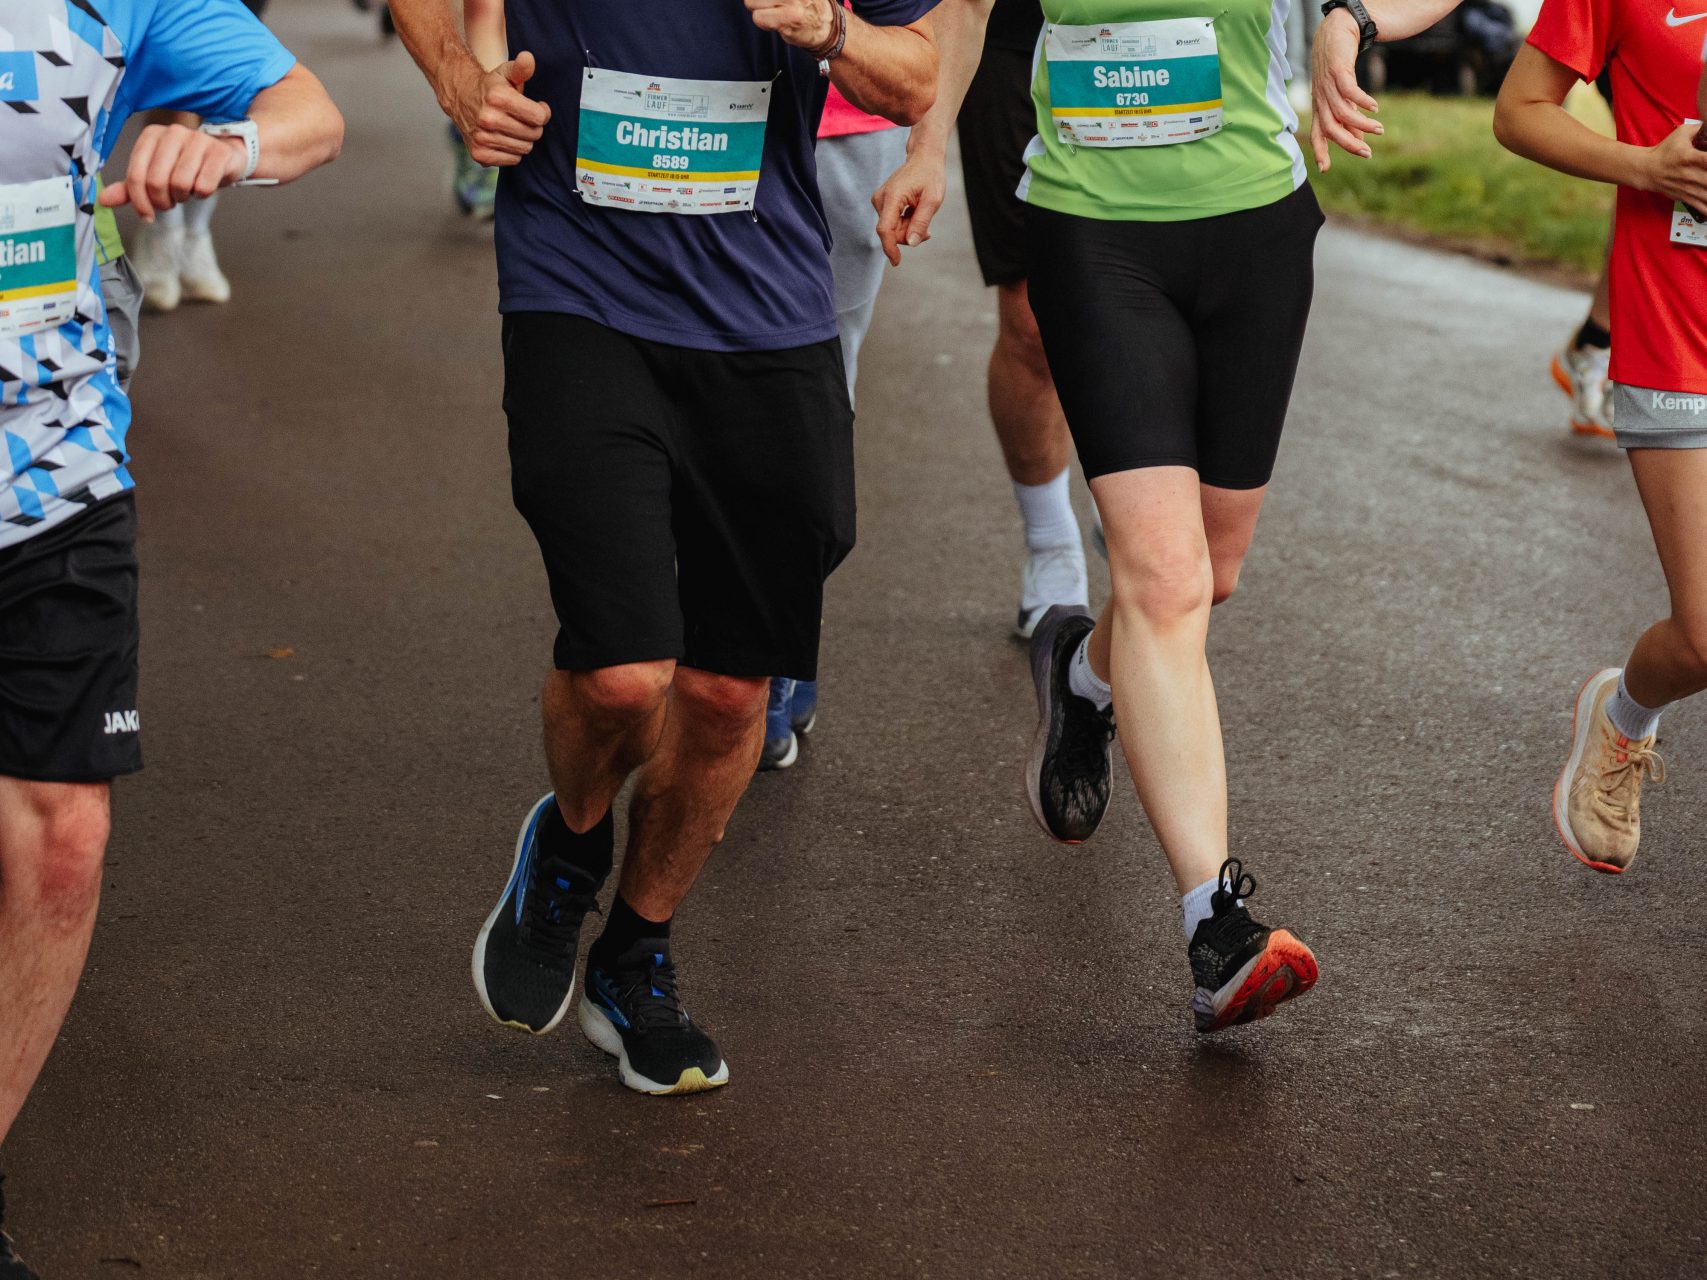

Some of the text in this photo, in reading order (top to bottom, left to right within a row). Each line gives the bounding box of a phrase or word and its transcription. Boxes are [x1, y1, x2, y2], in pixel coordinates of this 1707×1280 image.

[1093, 65, 1170, 88] Sabine
[646, 101, 668, 110] LAUF
[1116, 92, 1149, 106] 6730
[616, 120, 728, 151] Christian
[652, 154, 689, 169] 8589
[104, 710, 140, 734] JAK
